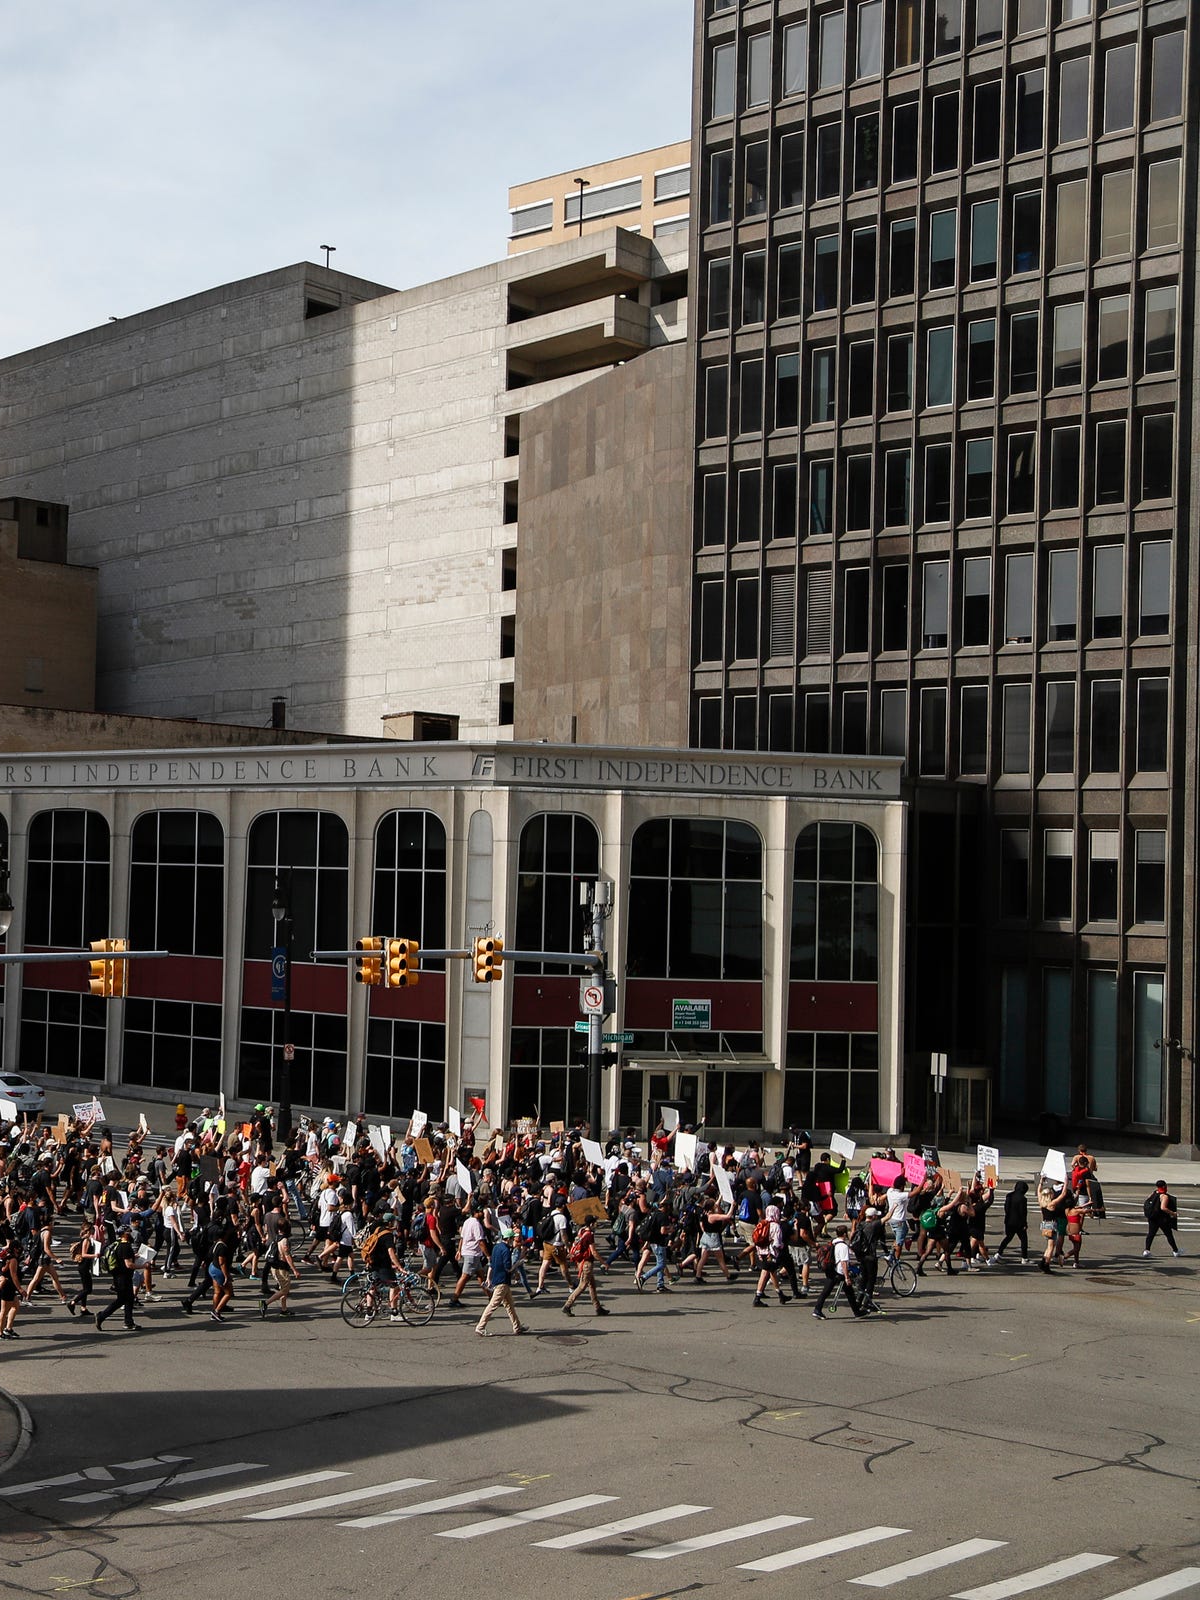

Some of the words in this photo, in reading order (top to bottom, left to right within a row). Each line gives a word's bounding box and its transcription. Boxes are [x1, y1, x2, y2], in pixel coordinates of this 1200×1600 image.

[72, 759, 318, 783] INDEPENDENCE
[343, 756, 439, 778] BANK
[511, 756, 583, 780] FIRST
[597, 759, 793, 787] INDEPENDENCE
[813, 768, 883, 790] BANK
[674, 1004, 709, 1012] AVAILABLE
[602, 1033, 633, 1042] Michigan
